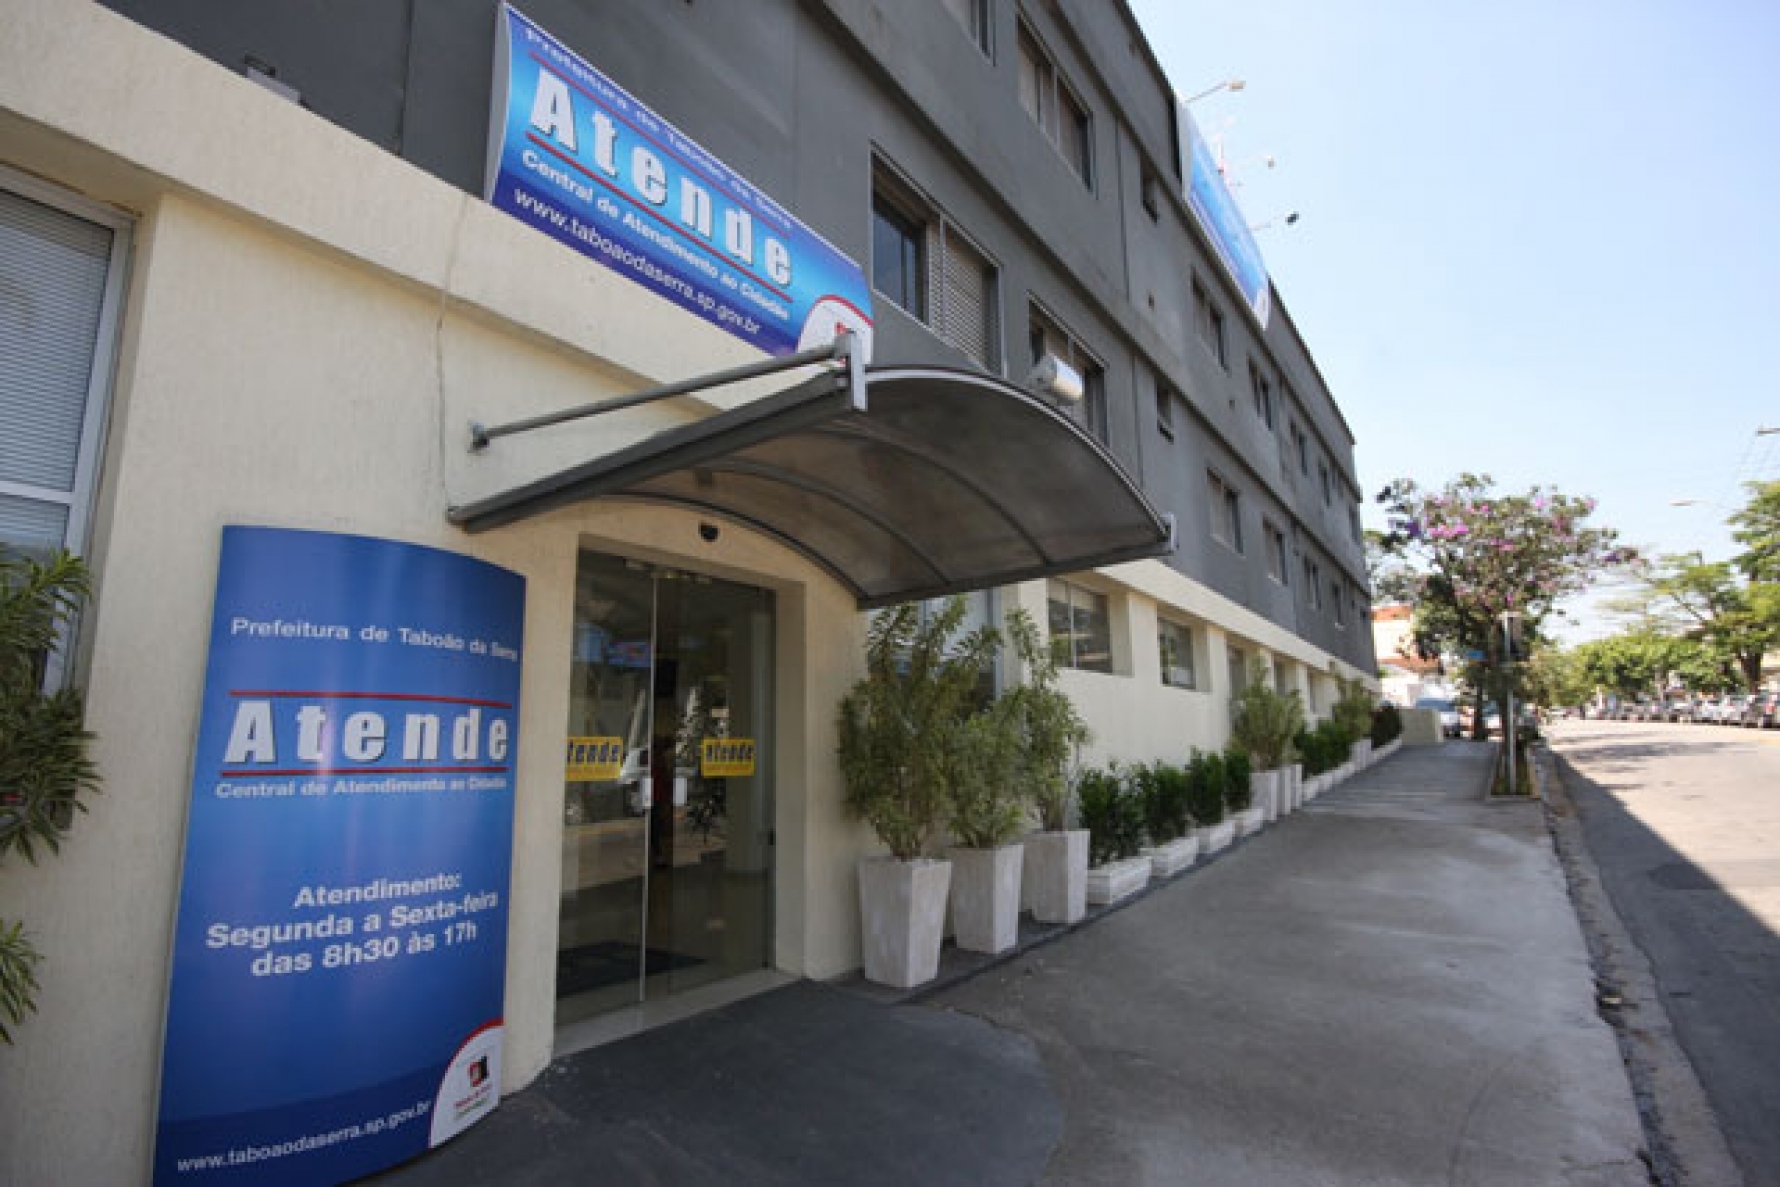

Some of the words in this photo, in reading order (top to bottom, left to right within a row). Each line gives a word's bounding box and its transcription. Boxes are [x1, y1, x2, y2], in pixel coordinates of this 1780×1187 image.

[529, 66, 792, 286] Atende
[522, 148, 594, 203] Central
[597, 197, 619, 219] de
[623, 211, 719, 279] Atendimento
[514, 188, 761, 335] www.taboaodaserra.sp.gov.br
[229, 616, 350, 641] Prefeitura
[358, 624, 390, 643] de
[397, 626, 466, 651] Taboão
[469, 639, 488, 655] da
[221, 699, 509, 764] Atende
[214, 779, 296, 799] Central
[299, 780, 328, 796] de
[332, 778, 446, 795] Atendimento
[205, 913, 354, 949] Segunda
[363, 913, 382, 933] a
[389, 890, 499, 928] Sexta-feira
[293, 872, 462, 910] Atendimento:
[251, 950, 313, 977] das
[322, 936, 400, 968] 8h30
[406, 931, 435, 954] às
[444, 920, 478, 946] 17h
[177, 1100, 431, 1171] www.taboaodaserra.sp.gov.br
